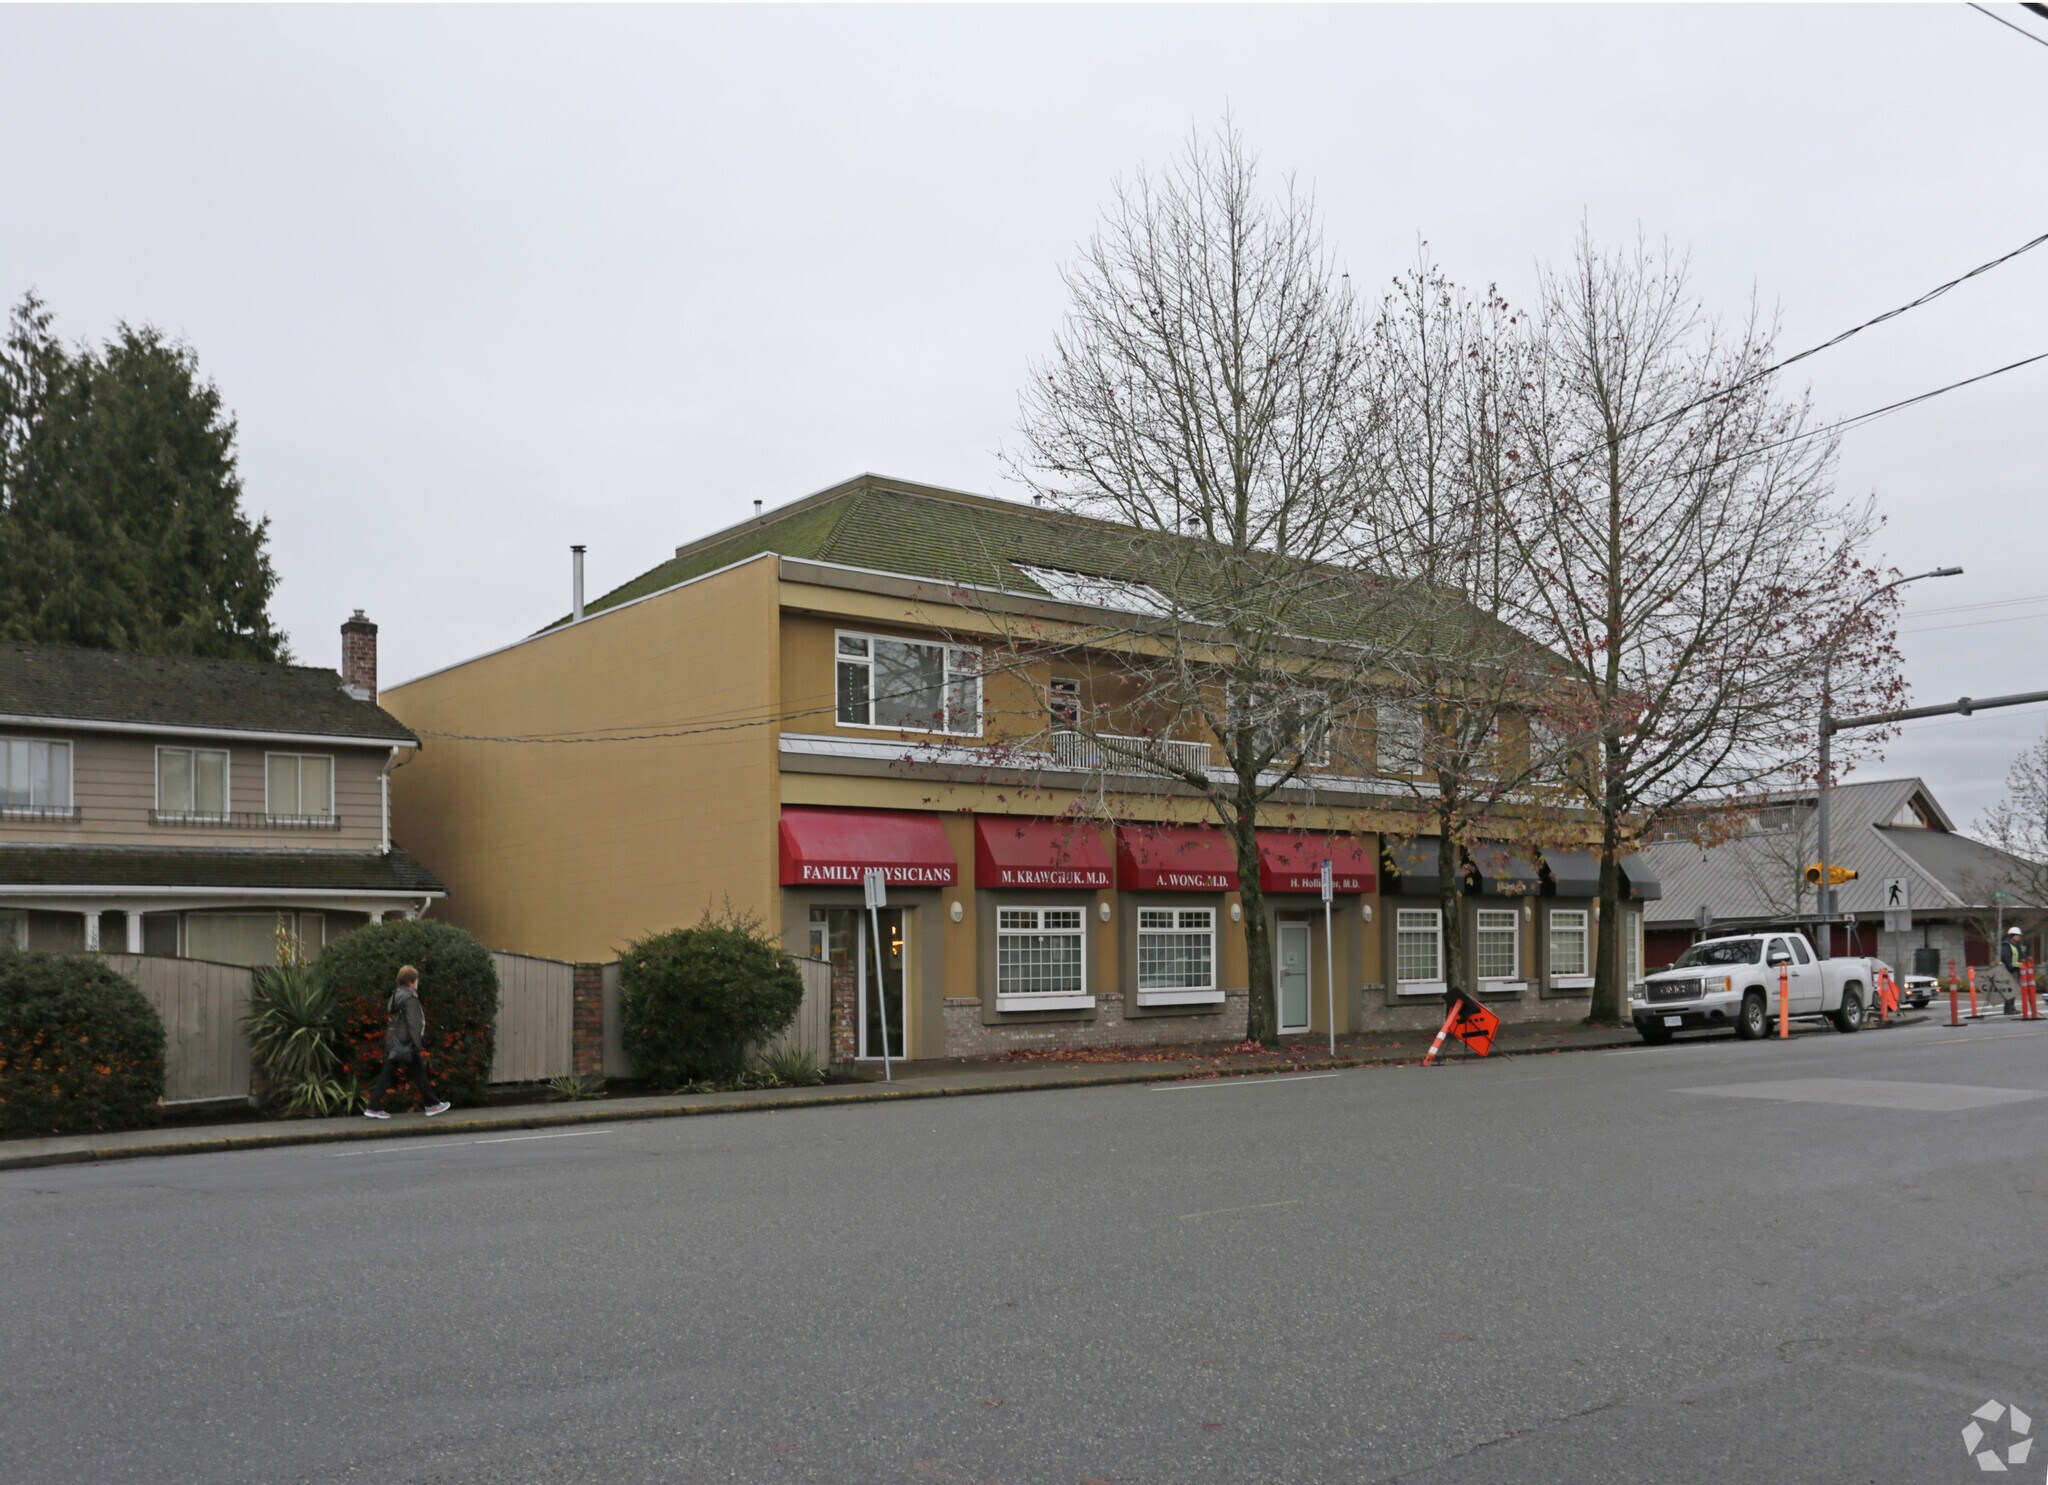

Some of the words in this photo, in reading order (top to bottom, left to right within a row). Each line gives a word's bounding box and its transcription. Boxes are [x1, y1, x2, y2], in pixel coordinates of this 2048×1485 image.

[803, 865, 861, 880] FAMILY
[1002, 870, 1015, 883] M.
[1086, 872, 1109, 884] M.D.
[1156, 874, 1167, 886] A.
[1290, 878, 1299, 888] H.
[1343, 879, 1361, 889] M.D.
